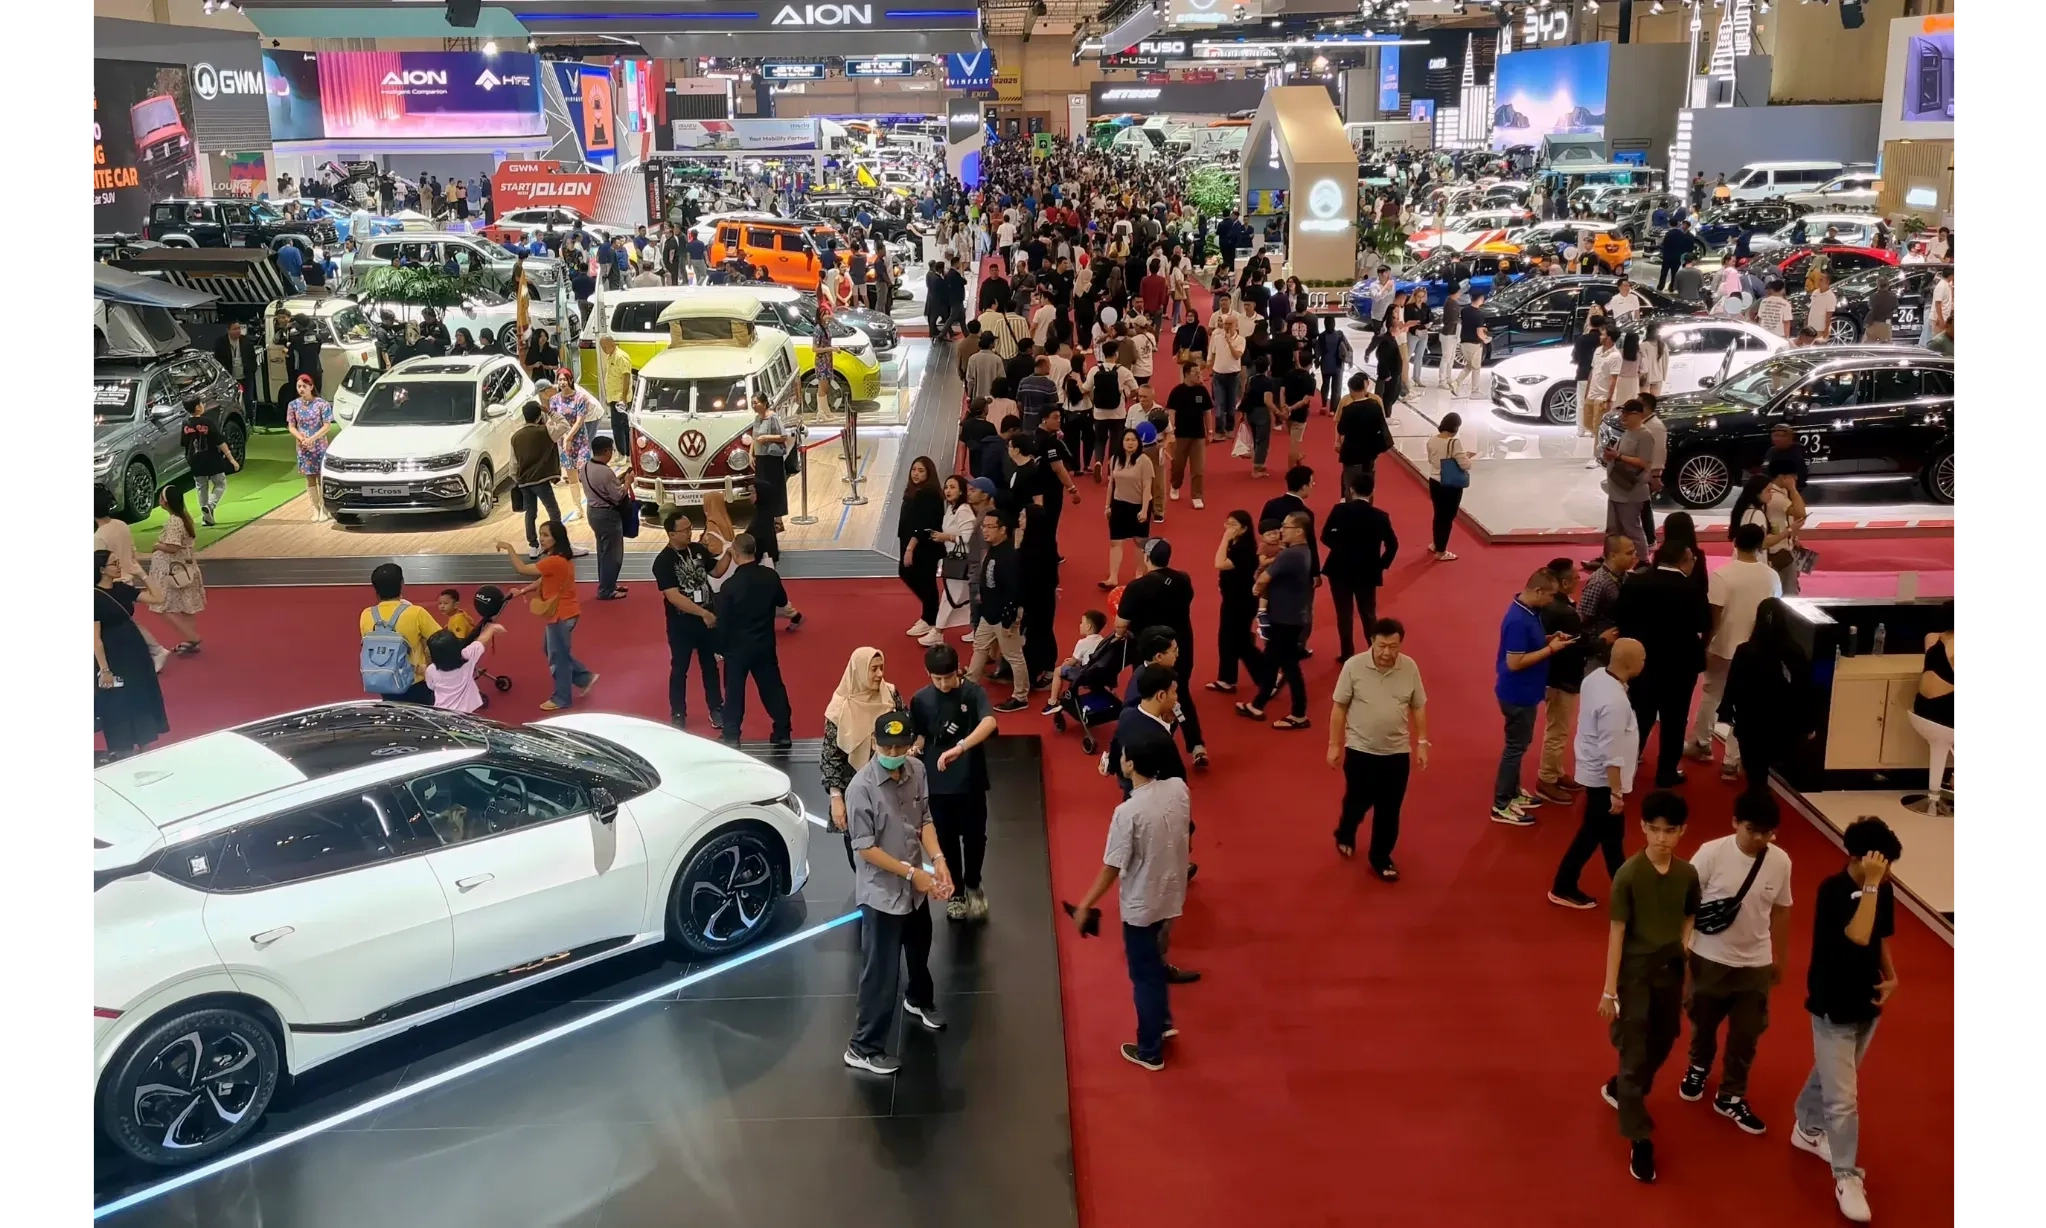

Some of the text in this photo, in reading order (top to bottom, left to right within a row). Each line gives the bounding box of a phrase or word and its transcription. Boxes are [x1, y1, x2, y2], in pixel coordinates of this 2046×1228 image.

[771, 4, 872, 25] AION
[1140, 42, 1185, 53] FUSO
[219, 70, 264, 94] GWM
[381, 70, 447, 85] AION
[951, 113, 979, 122] AION
[509, 164, 538, 172] GWM
[114, 167, 139, 187] CAR
[500, 182, 531, 191] START
[528, 182, 592, 200] JOLION
[1898, 309, 1913, 323] 26
